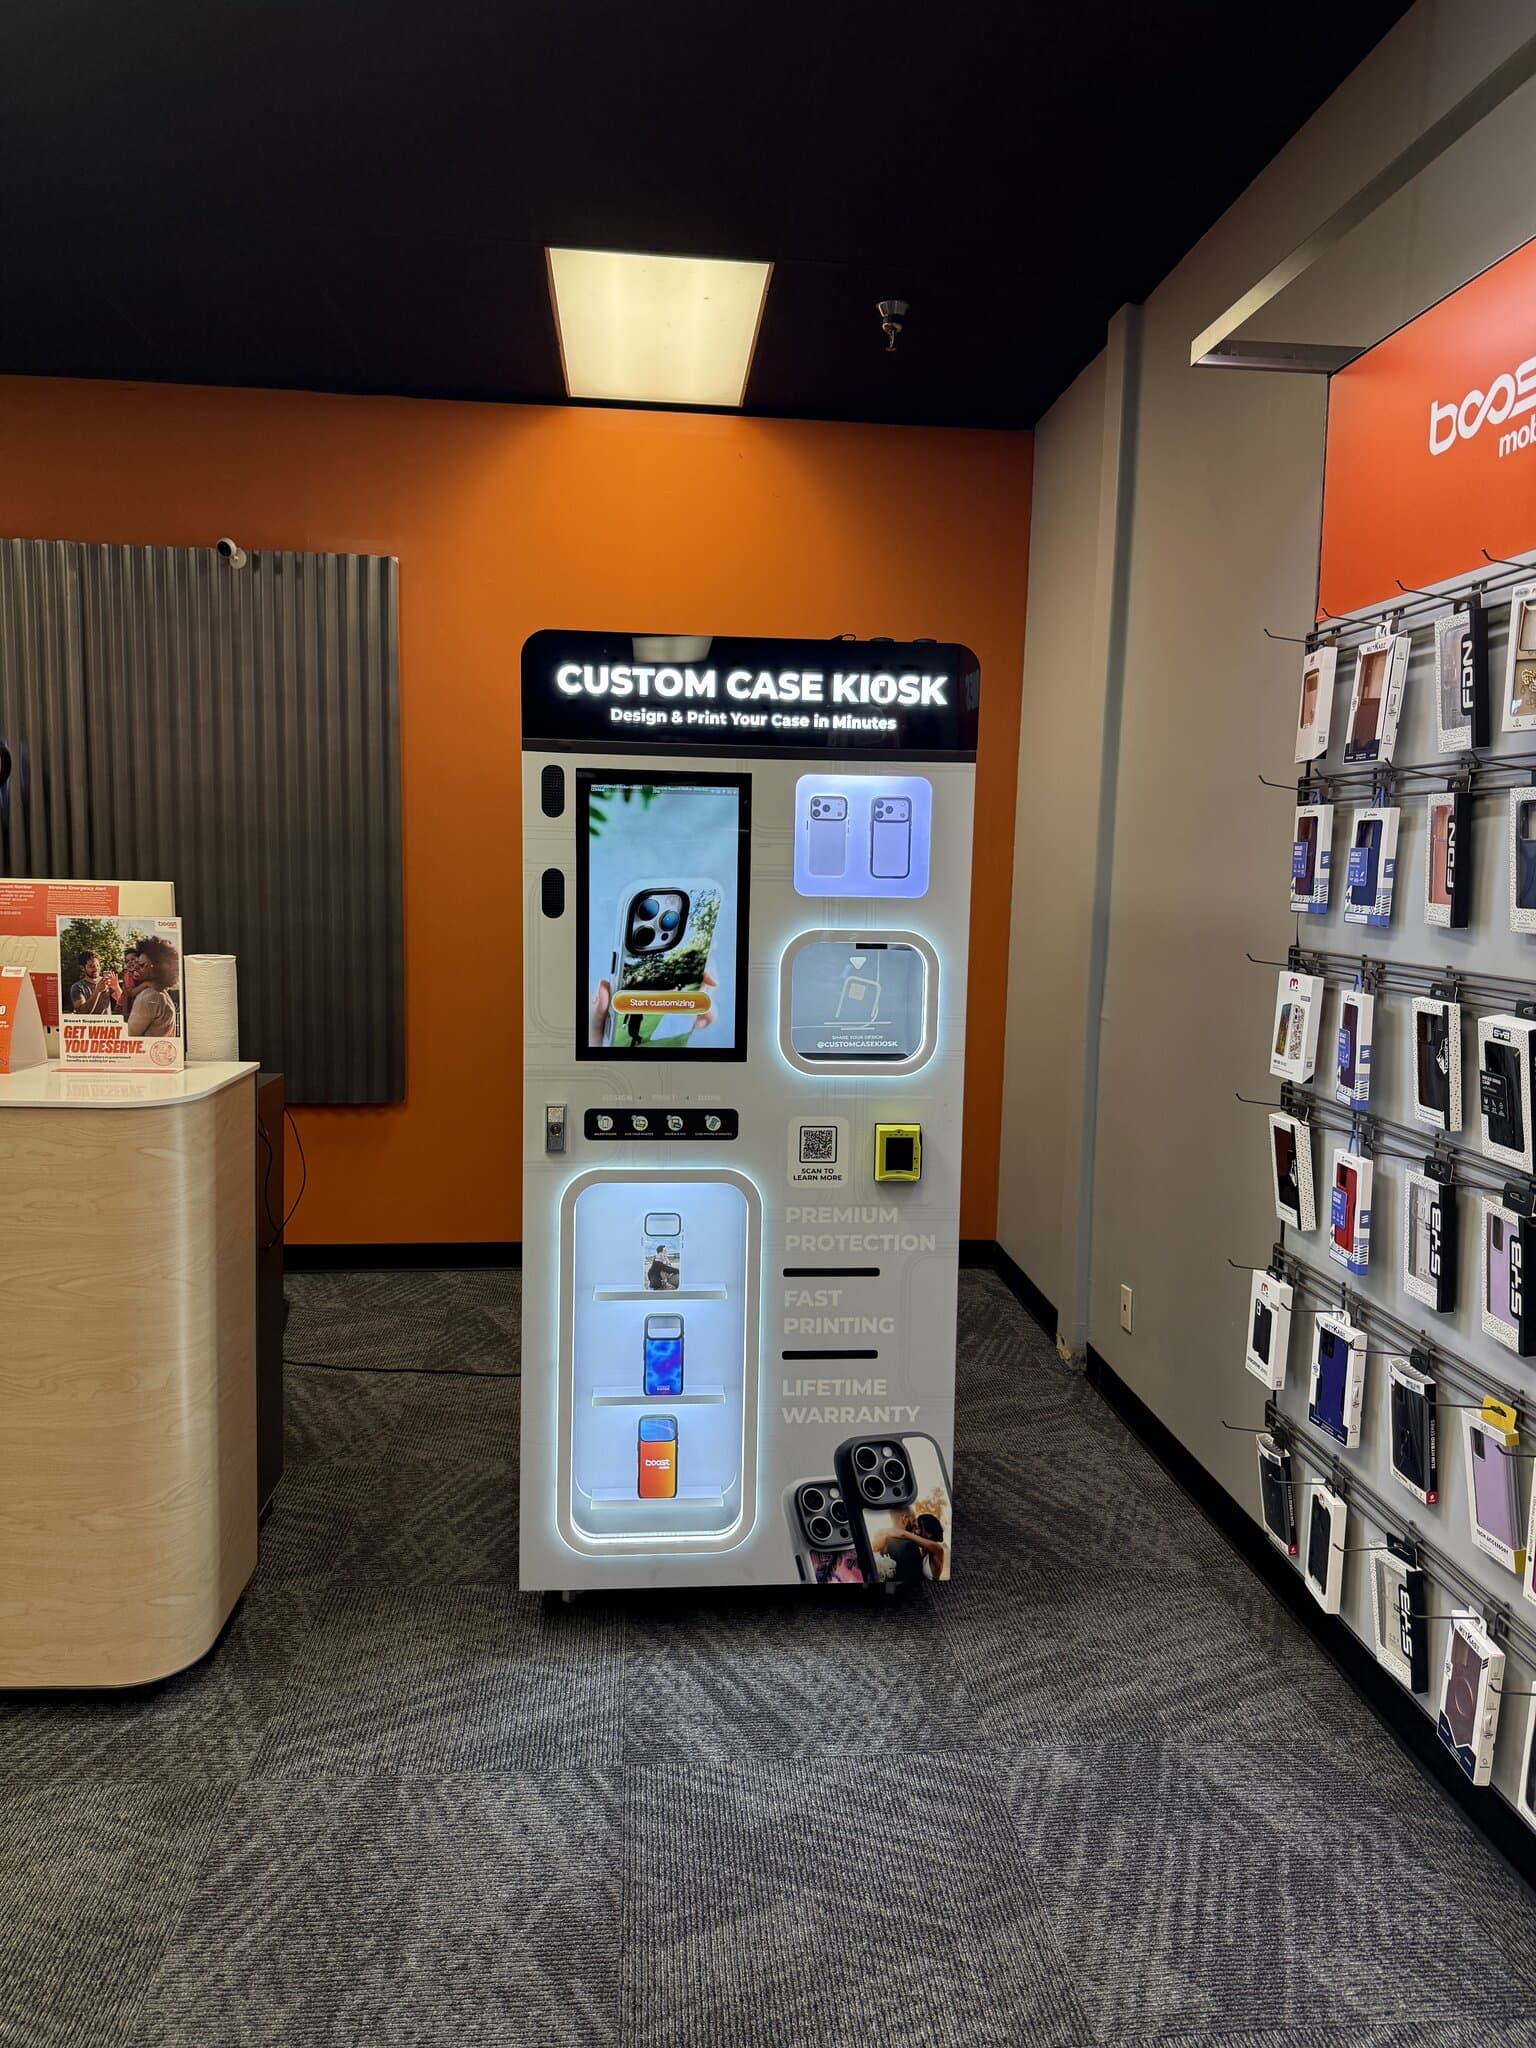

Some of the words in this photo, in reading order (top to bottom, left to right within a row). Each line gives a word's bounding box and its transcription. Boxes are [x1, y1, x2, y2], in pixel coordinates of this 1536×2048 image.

[556, 664, 716, 698] CUSTOM
[726, 669, 824, 701] CASE
[832, 672, 948, 705] KIOSK
[610, 708, 668, 725] Design
[671, 711, 683, 724] &
[687, 710, 727, 725] Print
[730, 712, 767, 727] Your
[771, 714, 810, 727] Case
[813, 713, 829, 728] in
[832, 715, 897, 730] Minutes
[630, 998, 649, 1007] Start
[650, 999, 695, 1009] customizing
[64, 1025, 87, 1039] GET
[89, 1025, 122, 1040] WHAT
[65, 1040, 89, 1053] YOU
[90, 1040, 145, 1054] DESERVE.
[785, 1207, 899, 1224] PREMIUM
[785, 1234, 936, 1251] PROTECTION
[784, 1289, 843, 1307] FAST
[783, 1317, 895, 1334] PRINTING
[782, 1379, 888, 1396] LIFETIME
[782, 1405, 921, 1424] WARRANTY
[645, 1459, 670, 1467] boost
